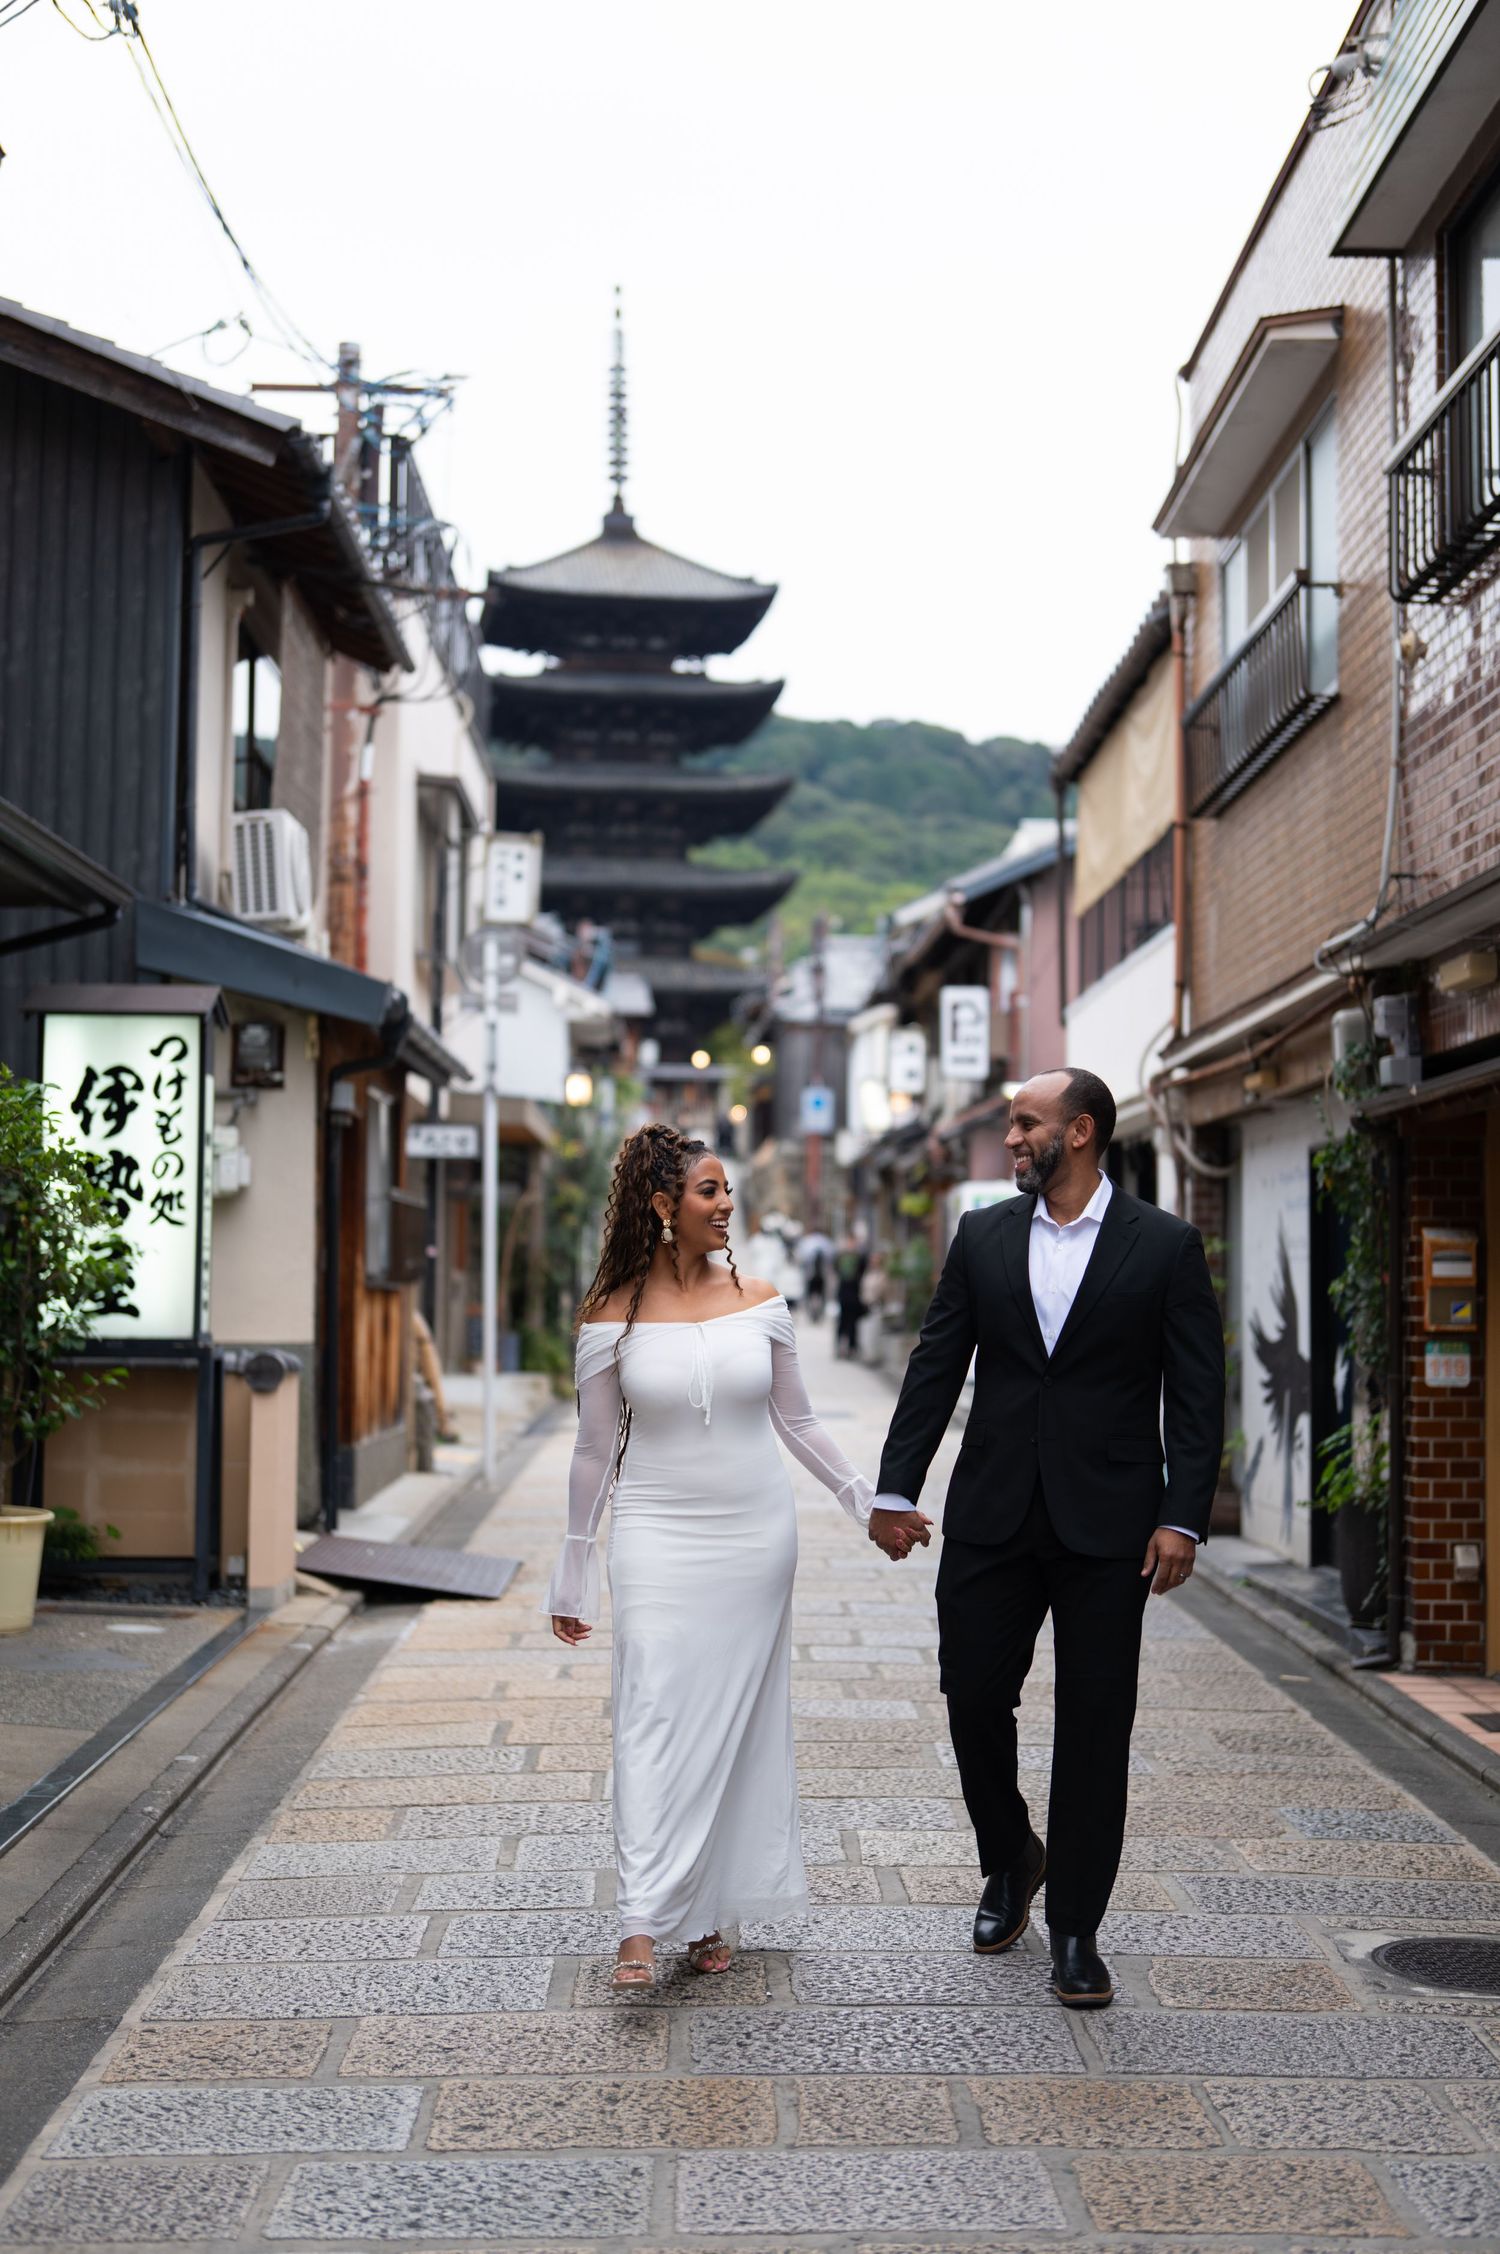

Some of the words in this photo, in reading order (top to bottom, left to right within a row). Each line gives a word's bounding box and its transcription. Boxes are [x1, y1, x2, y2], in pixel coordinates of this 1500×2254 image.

[150, 1036, 188, 1226] つけもの処
